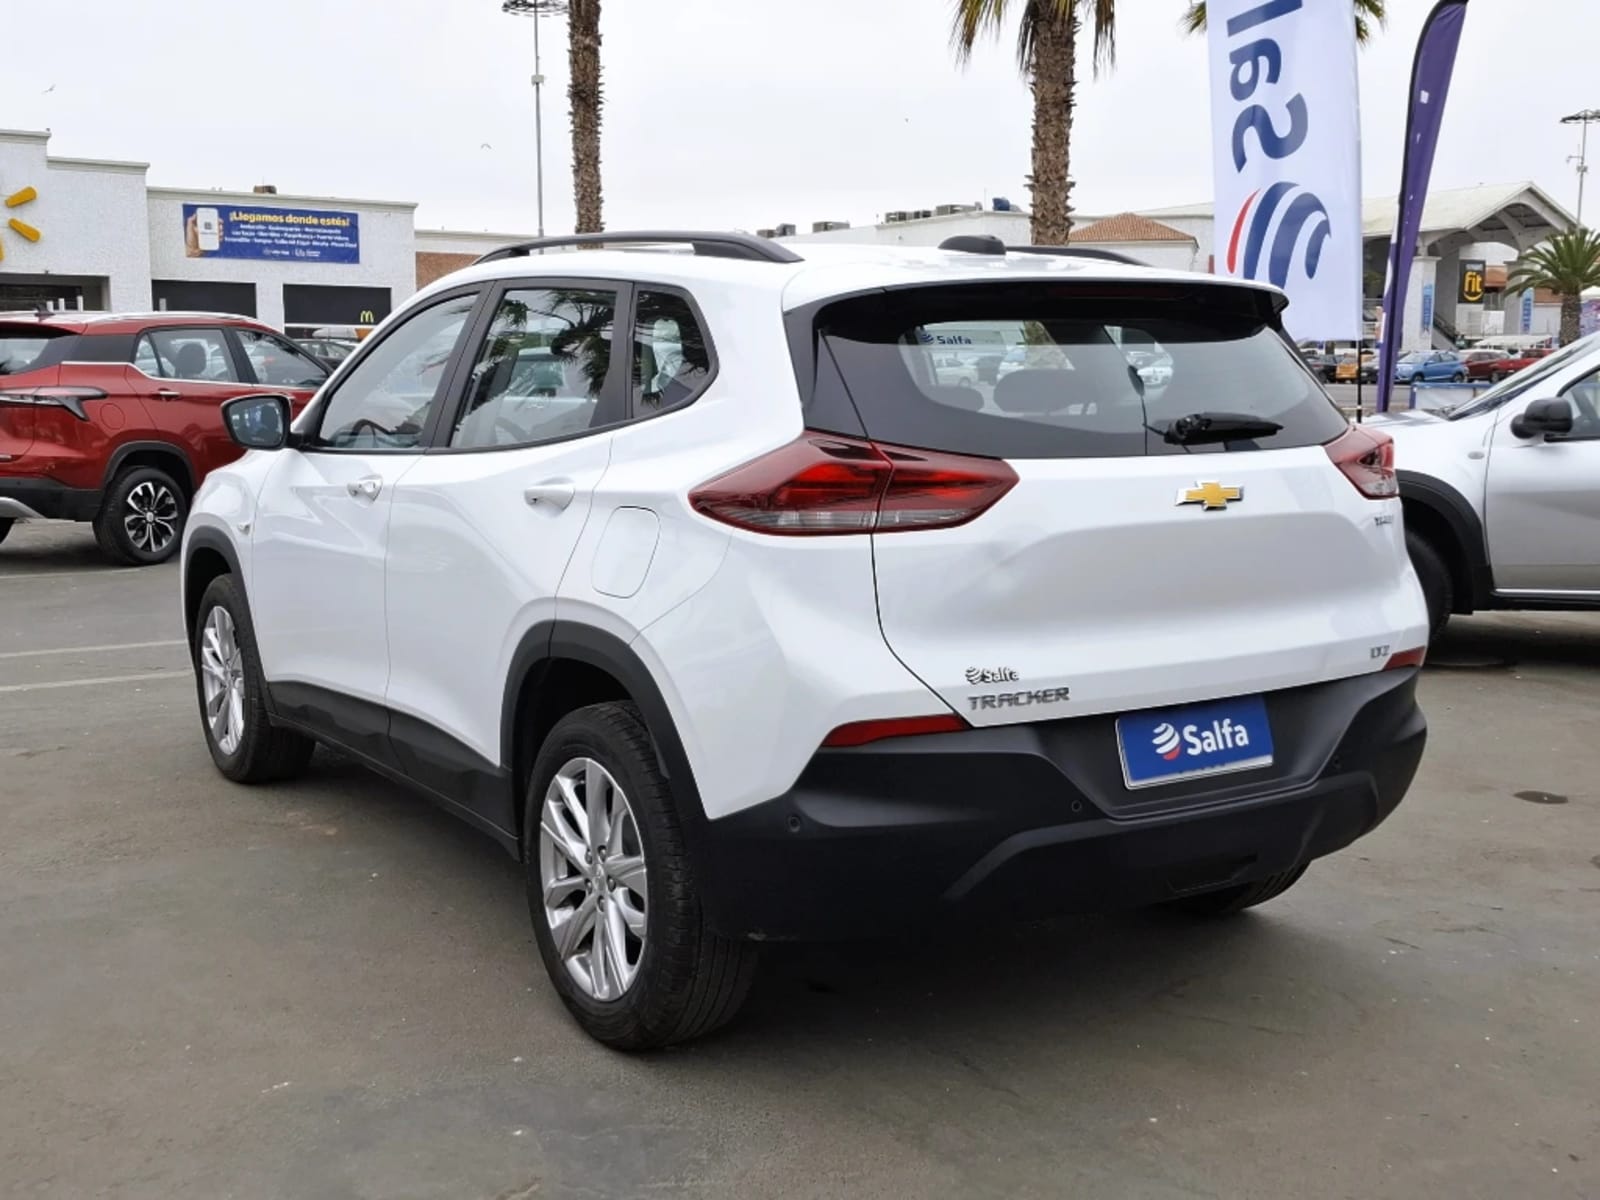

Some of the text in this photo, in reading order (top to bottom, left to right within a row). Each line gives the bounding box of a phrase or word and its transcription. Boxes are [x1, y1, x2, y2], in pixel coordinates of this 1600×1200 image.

[285, 214, 319, 225] donde
[320, 216, 350, 227] estés!
[1464, 271, 1482, 292] fit
[936, 335, 973, 345] Salfa
[982, 666, 1019, 683] Salfa
[967, 686, 1070, 710] TRACKER
[1182, 718, 1249, 755] Salfa
